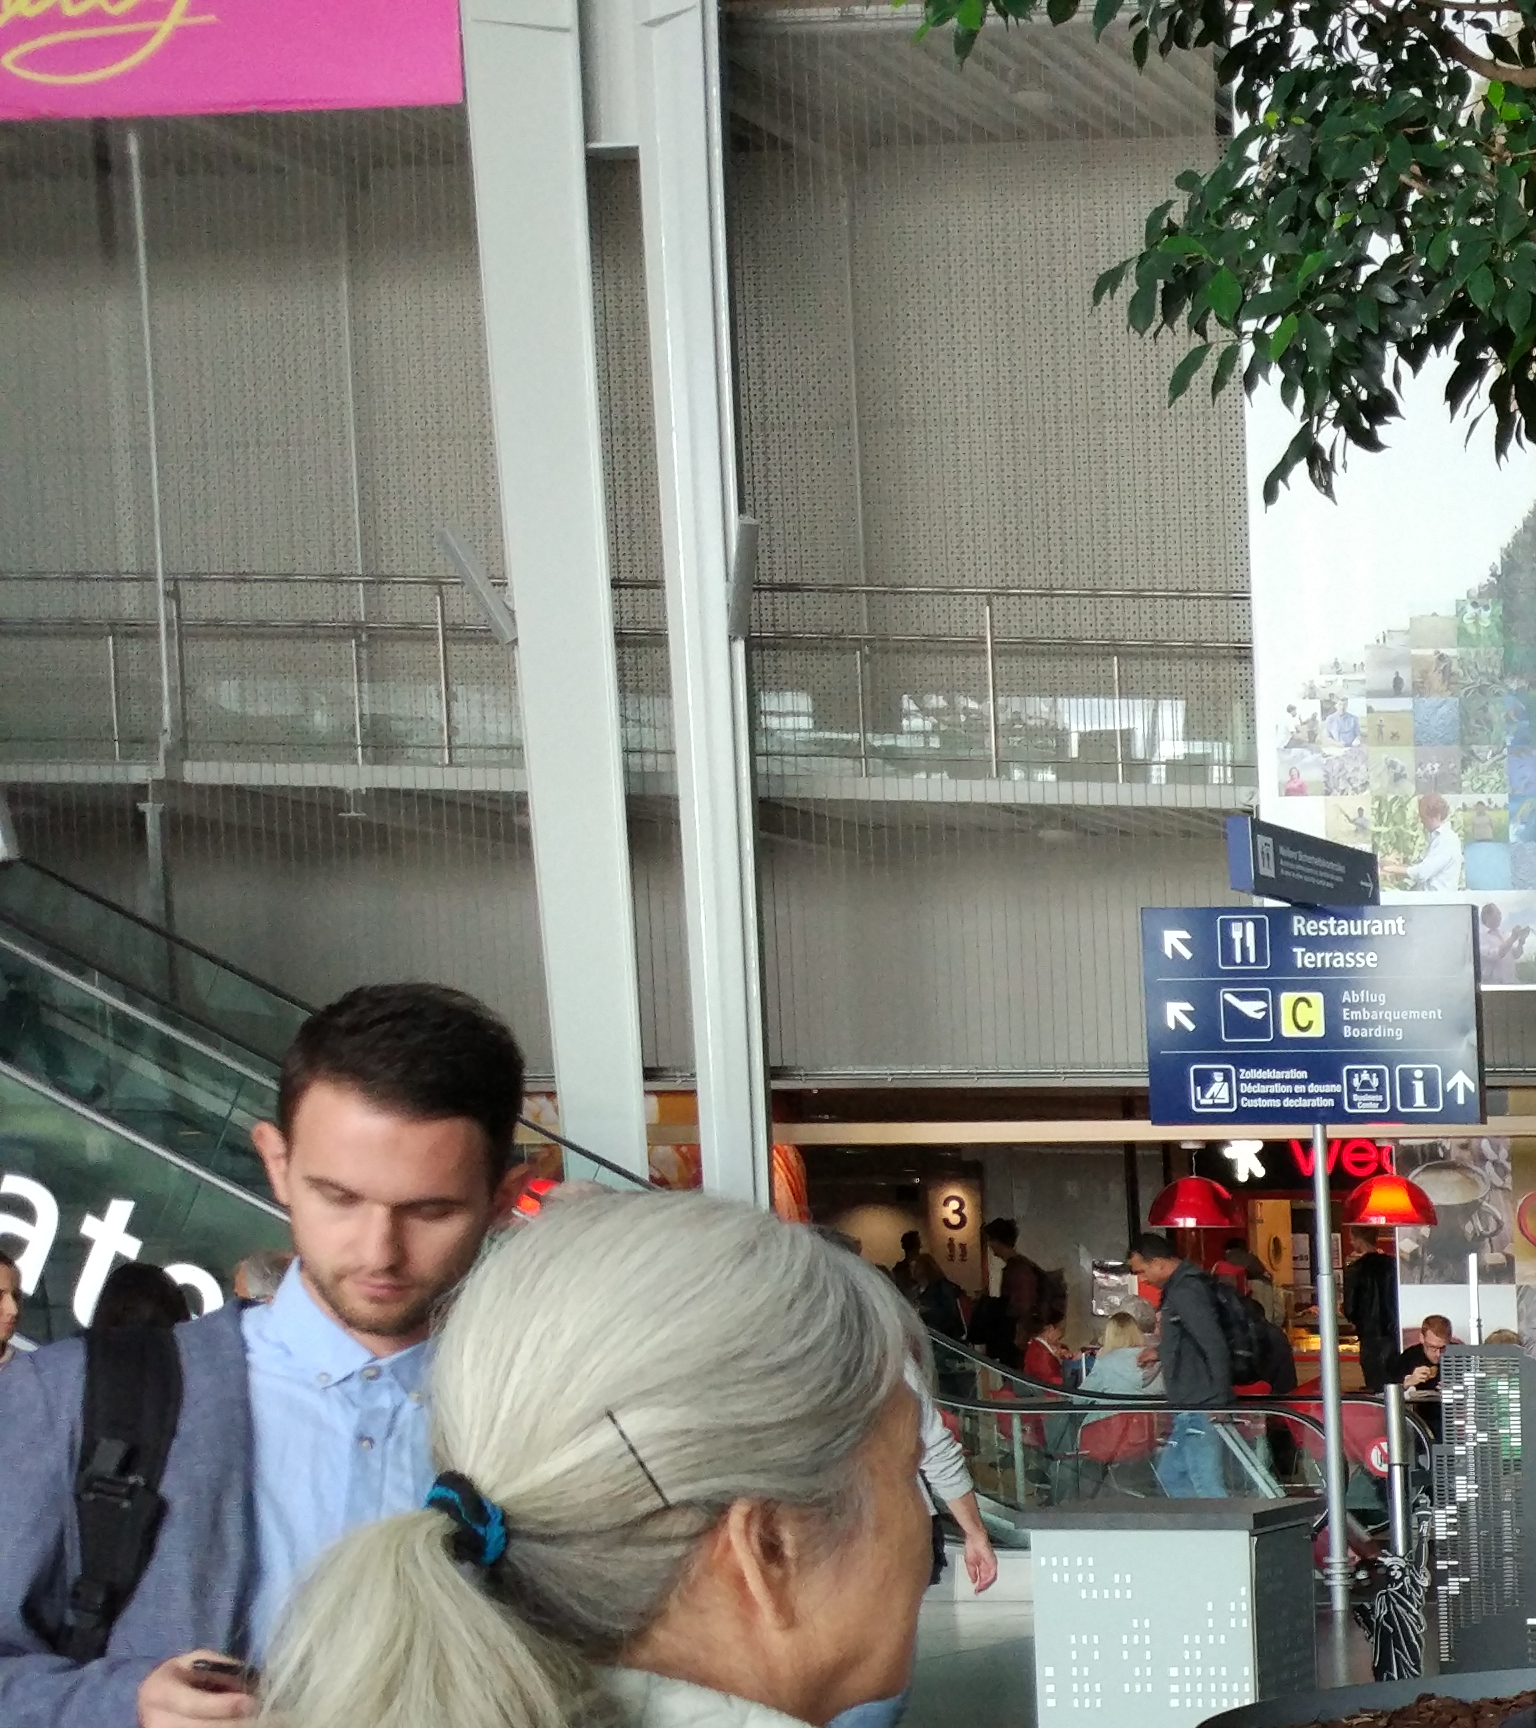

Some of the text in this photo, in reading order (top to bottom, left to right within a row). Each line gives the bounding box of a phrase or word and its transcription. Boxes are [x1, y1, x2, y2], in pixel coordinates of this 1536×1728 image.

[1292, 915, 1406, 937] Restaurant
[1292, 947, 1379, 968] Terrasse
[1341, 990, 1387, 1006] Abflug
[1291, 996, 1315, 1033] C
[1342, 1008, 1444, 1024] Embarquement
[1343, 1025, 1404, 1041] Boarding
[1239, 1068, 1308, 1081] Zolldeklaration
[1240, 1081, 1342, 1094] Déclaration en douane
[1240, 1096, 1335, 1109] Customs declaration
[942, 1195, 968, 1231] 3
